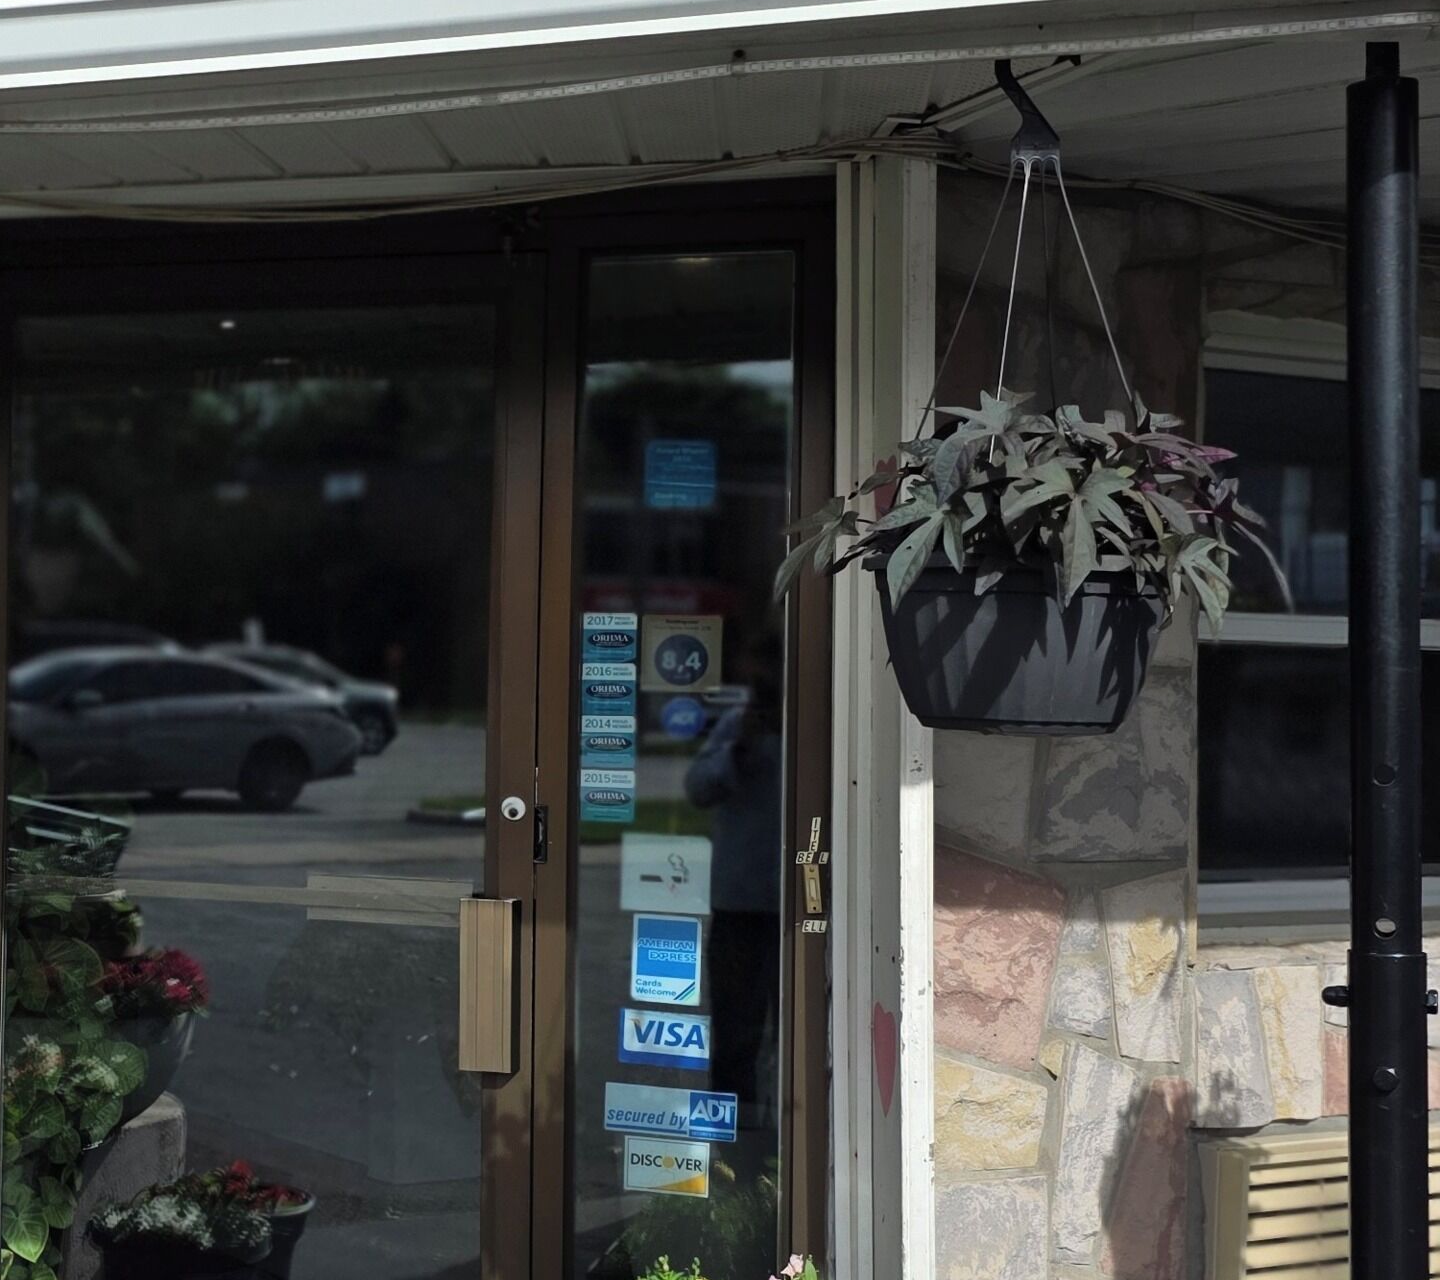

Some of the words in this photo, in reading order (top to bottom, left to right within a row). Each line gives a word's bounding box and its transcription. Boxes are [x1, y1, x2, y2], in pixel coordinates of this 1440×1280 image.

[587, 615, 614, 626] 2017
[585, 666, 611, 676] 2016
[585, 718, 611, 729] 2014
[584, 773, 611, 783] 2015
[637, 937, 694, 951] AMERICAN
[648, 950, 696, 963] EXPRESS
[635, 978, 662, 987] Cards
[635, 986, 677, 997] Welcome
[632, 1019, 705, 1050] VISA
[607, 1108, 665, 1125] secured
[669, 1113, 687, 1129] by
[690, 1098, 736, 1124] ADT
[630, 1153, 702, 1172] DISCOVER
